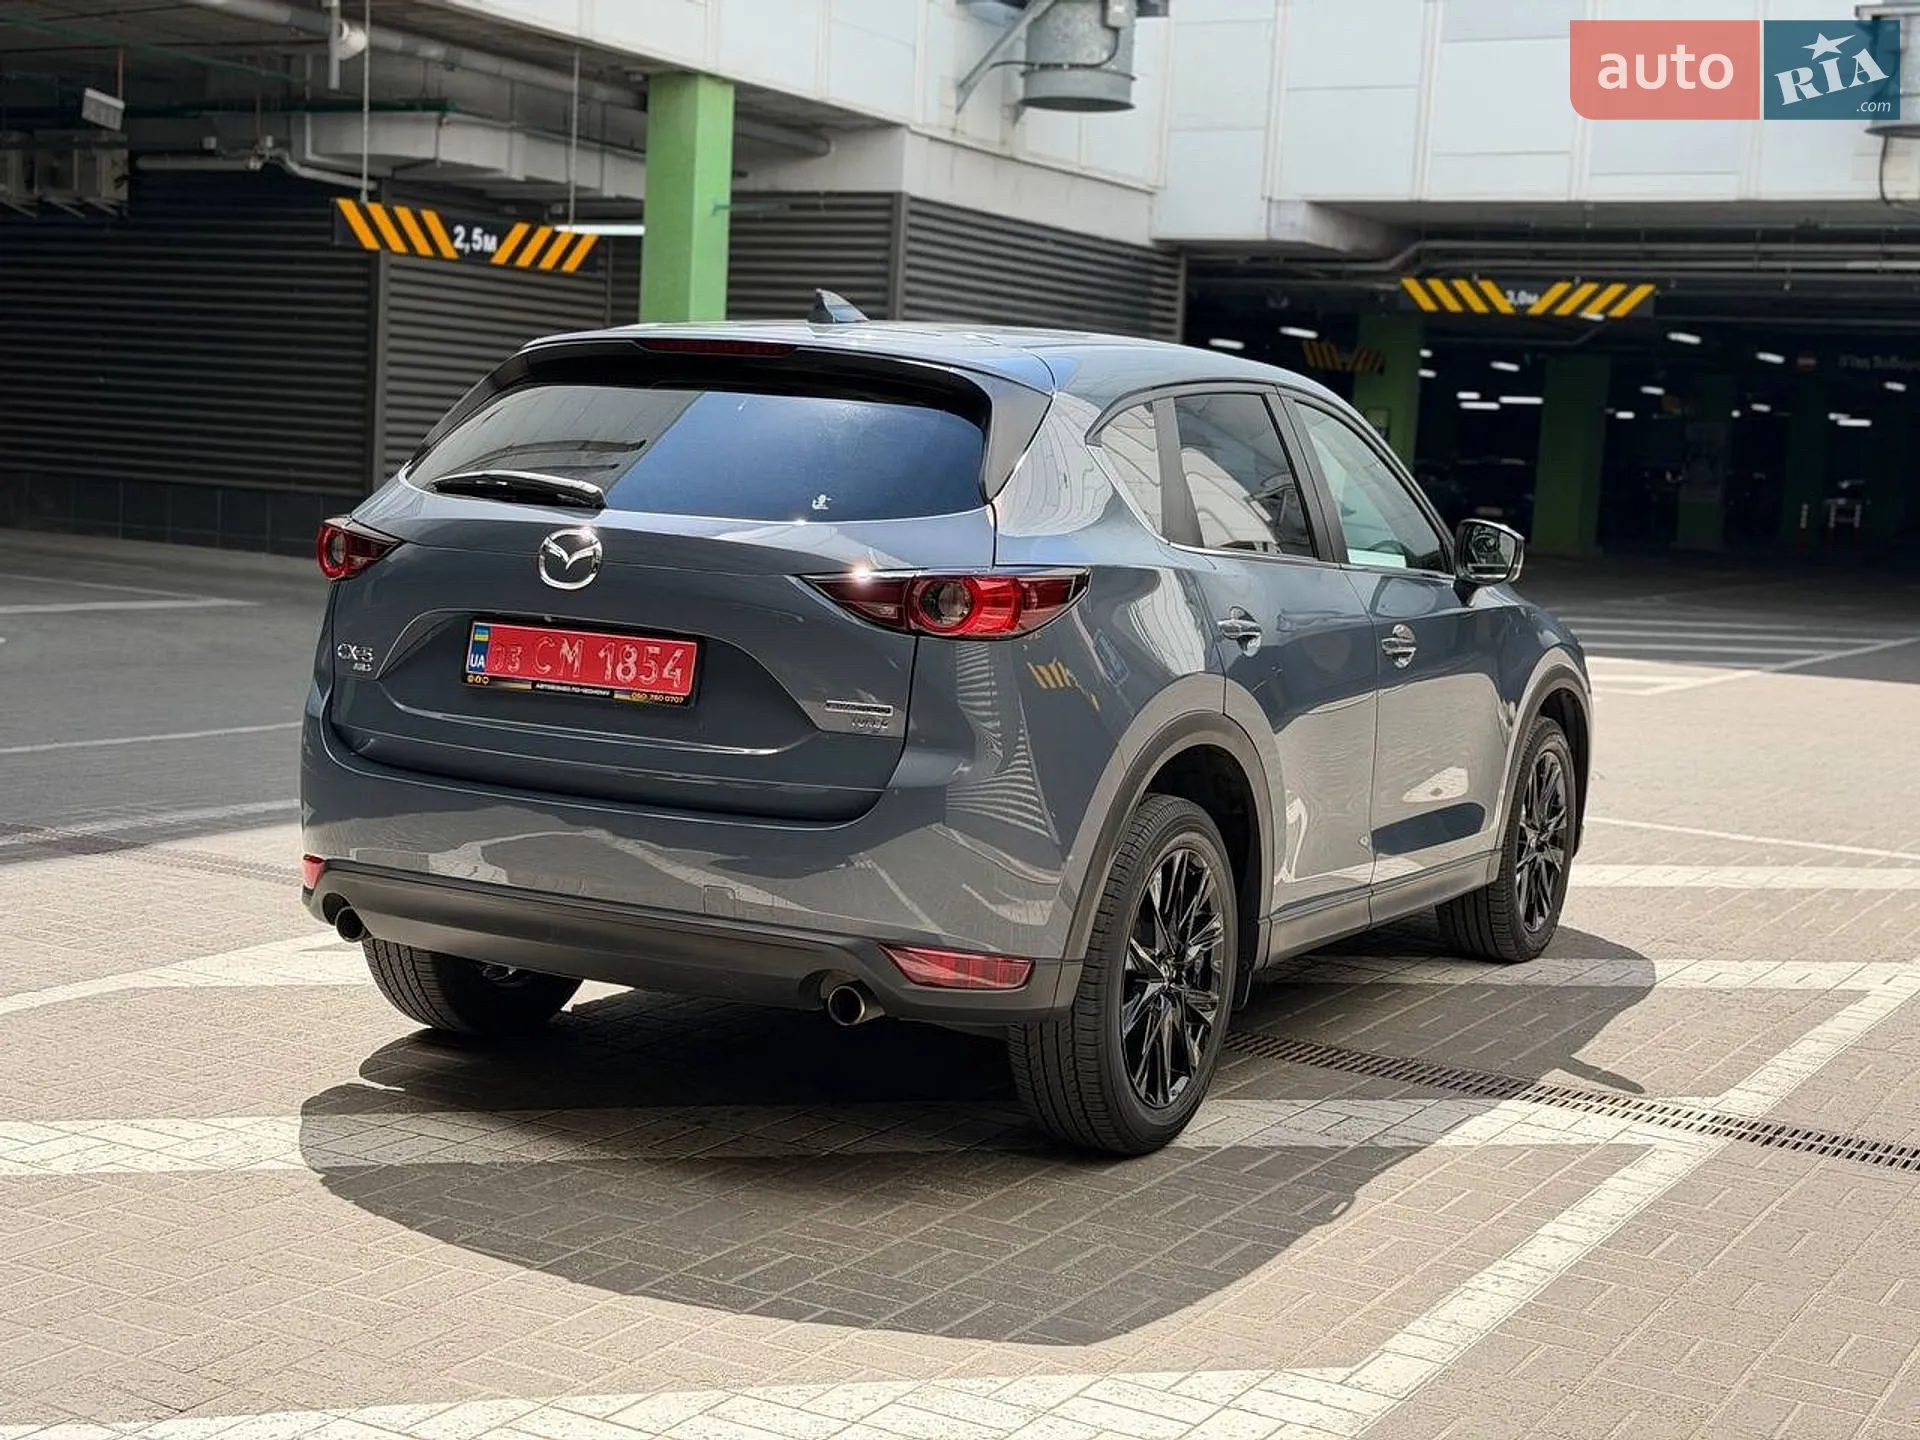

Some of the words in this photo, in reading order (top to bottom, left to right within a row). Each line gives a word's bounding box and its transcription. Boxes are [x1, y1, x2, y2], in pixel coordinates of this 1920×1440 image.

[469, 652, 487, 669] UA
[534, 635, 585, 679] CM
[598, 640, 686, 689] 1854
